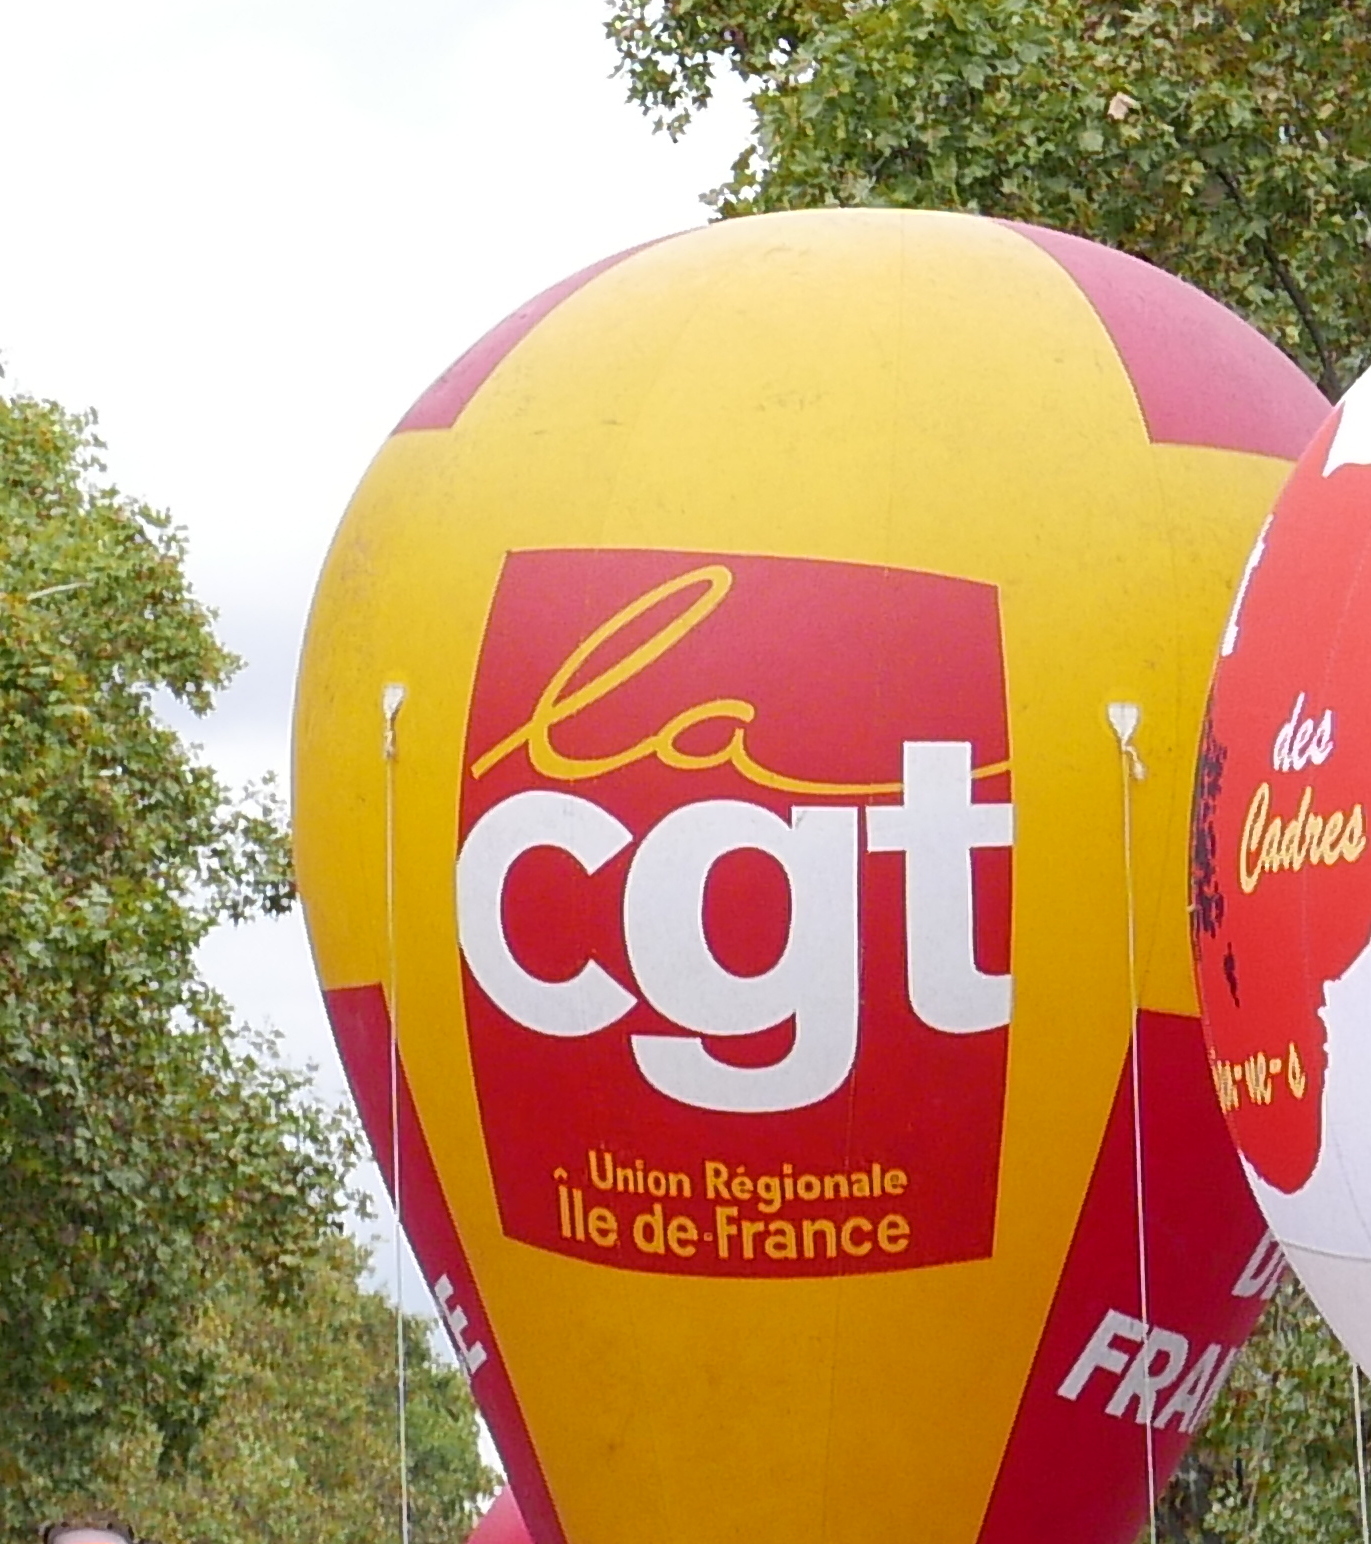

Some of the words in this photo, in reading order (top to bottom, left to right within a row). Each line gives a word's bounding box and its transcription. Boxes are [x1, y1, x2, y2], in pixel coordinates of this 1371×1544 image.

[472, 565, 904, 794] la
[1272, 692, 1334, 772] des
[1240, 782, 1366, 894] Cadres
[455, 741, 1014, 1113] cgt
[588, 1149, 691, 1197] Union
[705, 1160, 908, 1212] Régionale
